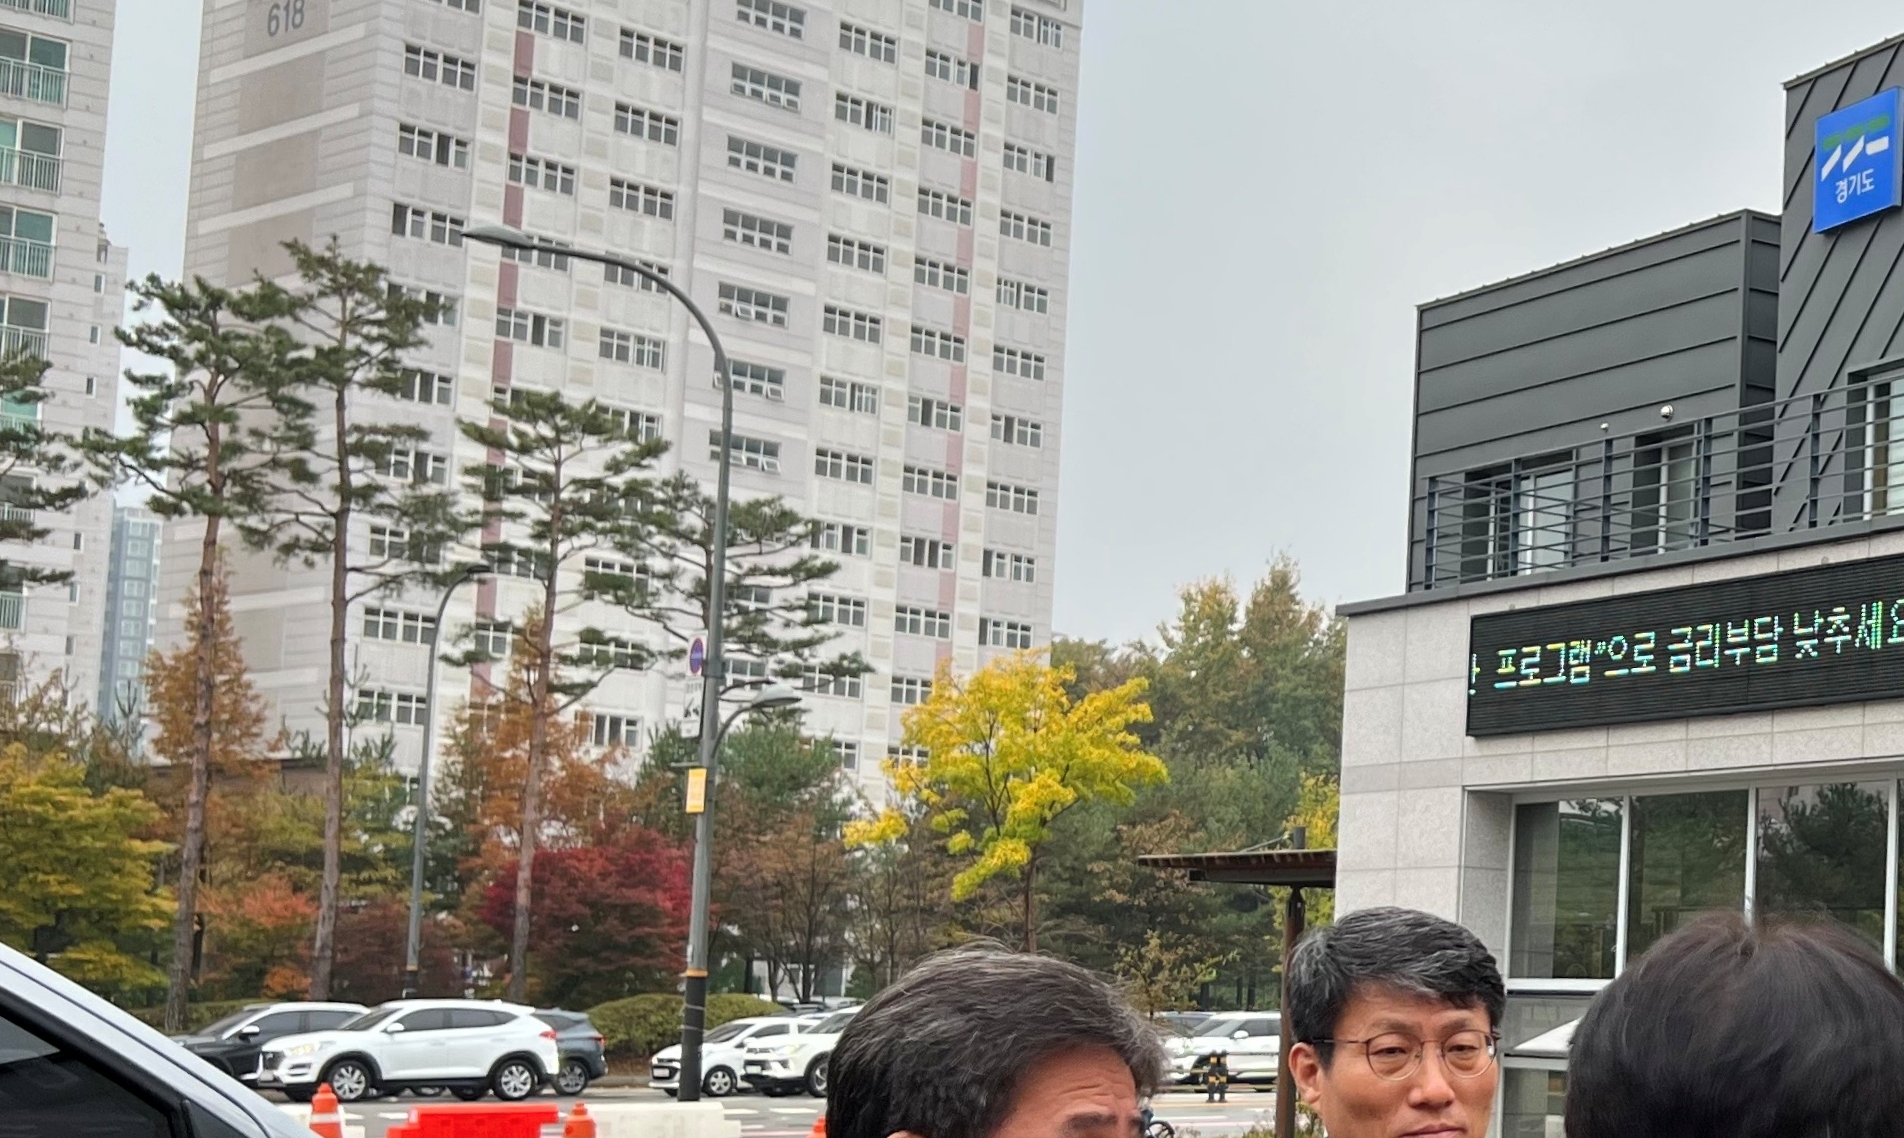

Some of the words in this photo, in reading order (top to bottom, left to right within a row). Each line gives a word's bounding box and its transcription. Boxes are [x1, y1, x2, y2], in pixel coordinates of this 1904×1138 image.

[267, 0, 304, 38] 618
[1835, 168, 1875, 203] 경기도
[1667, 614, 1784, 673] 금리부담
